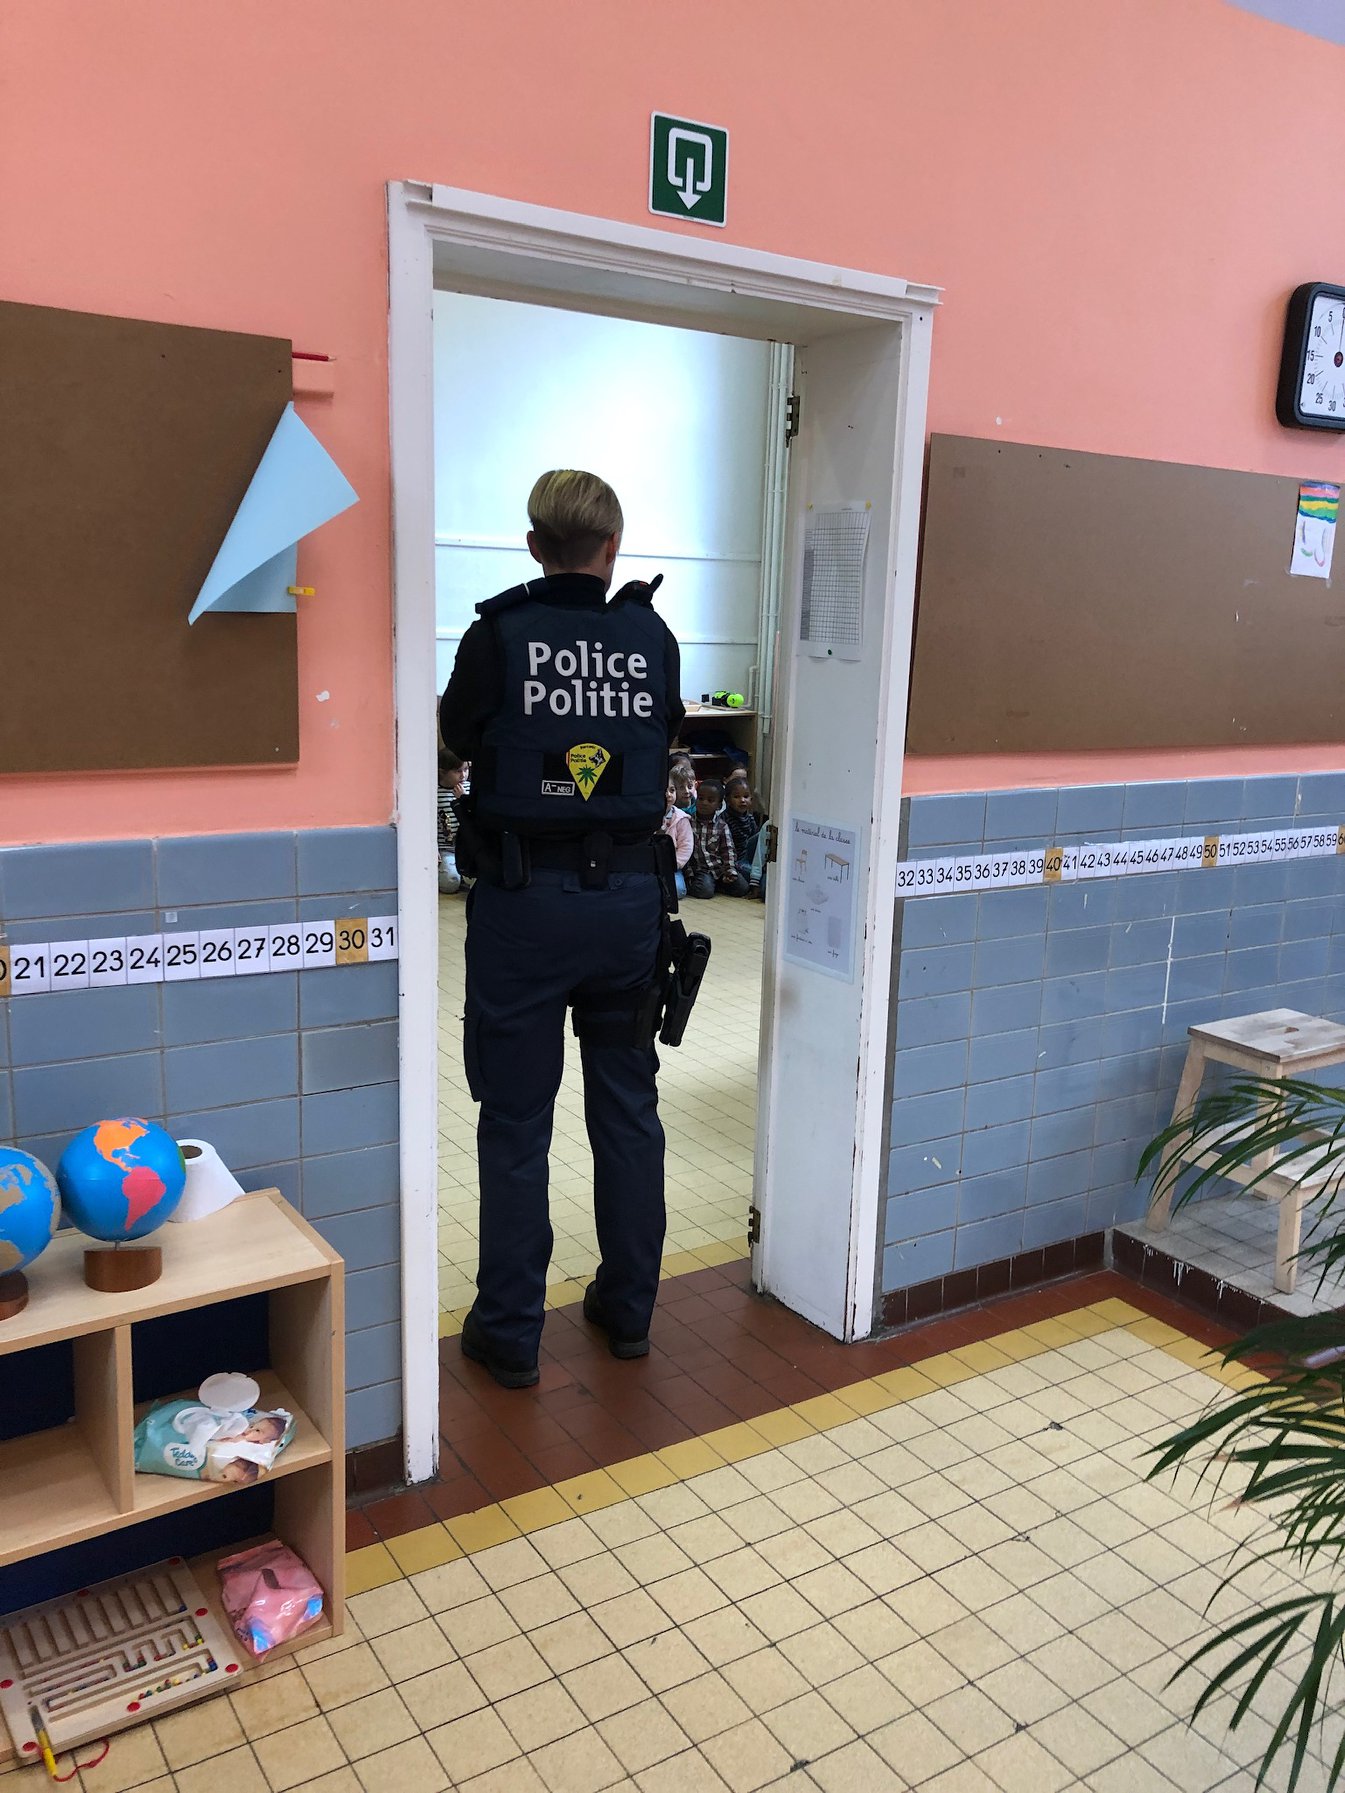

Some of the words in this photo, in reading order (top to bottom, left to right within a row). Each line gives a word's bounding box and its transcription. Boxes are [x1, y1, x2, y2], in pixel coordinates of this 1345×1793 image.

[1328, 311, 1333, 323] 5
[1314, 326, 1321, 338] 10
[1307, 350, 1314, 362] 15
[1307, 373, 1315, 385] 20
[1315, 393, 1323, 405] 25
[1328, 400, 1336, 412] 30
[528, 640, 648, 680] Police
[523, 679, 654, 718] Politie
[557, 786, 571, 794] NEG
[897, 870, 915, 888] 32
[917, 868, 934, 885] 33
[936, 866, 953, 884] 34
[955, 865, 972, 882] 35
[974, 863, 991, 880] 36
[992, 862, 1008, 878] 37
[1010, 860, 1026, 876] 38
[1028, 858, 1044, 875] 39
[1045, 856, 1061, 872] 40
[1063, 855, 1078, 870] 41
[1080, 854, 1095, 869] 42
[1097, 852, 1111, 867] 43
[1113, 851, 1127, 866] 44
[1129, 850, 1144, 865] 45
[1145, 849, 1159, 863] 46
[1160, 847, 1174, 862] 47
[1175, 846, 1188, 861] 48
[1189, 844, 1203, 860] 49
[1203, 844, 1217, 858] 50
[1219, 843, 1231, 858] 51
[1232, 842, 1246, 856] 52
[1247, 840, 1260, 855] 53
[1260, 839, 1273, 854] 54
[1274, 838, 1287, 852] 55
[1287, 837, 1300, 851] 56
[1300, 835, 1313, 849] 57
[1313, 834, 1325, 848] 58
[1325, 833, 1337, 847] 59
[1338, 833, 1345, 845] 6
[14, 956, 46, 979] 21
[53, 953, 86, 977] 22
[92, 950, 125, 974] 23
[129, 948, 161, 970] 24
[166, 944, 197, 966] 25
[202, 941, 233, 962] 26
[237, 938, 266, 960] 27
[271, 934, 300, 957] 28
[305, 931, 334, 954] 29
[339, 929, 366, 950] 30
[371, 926, 395, 948] 31
